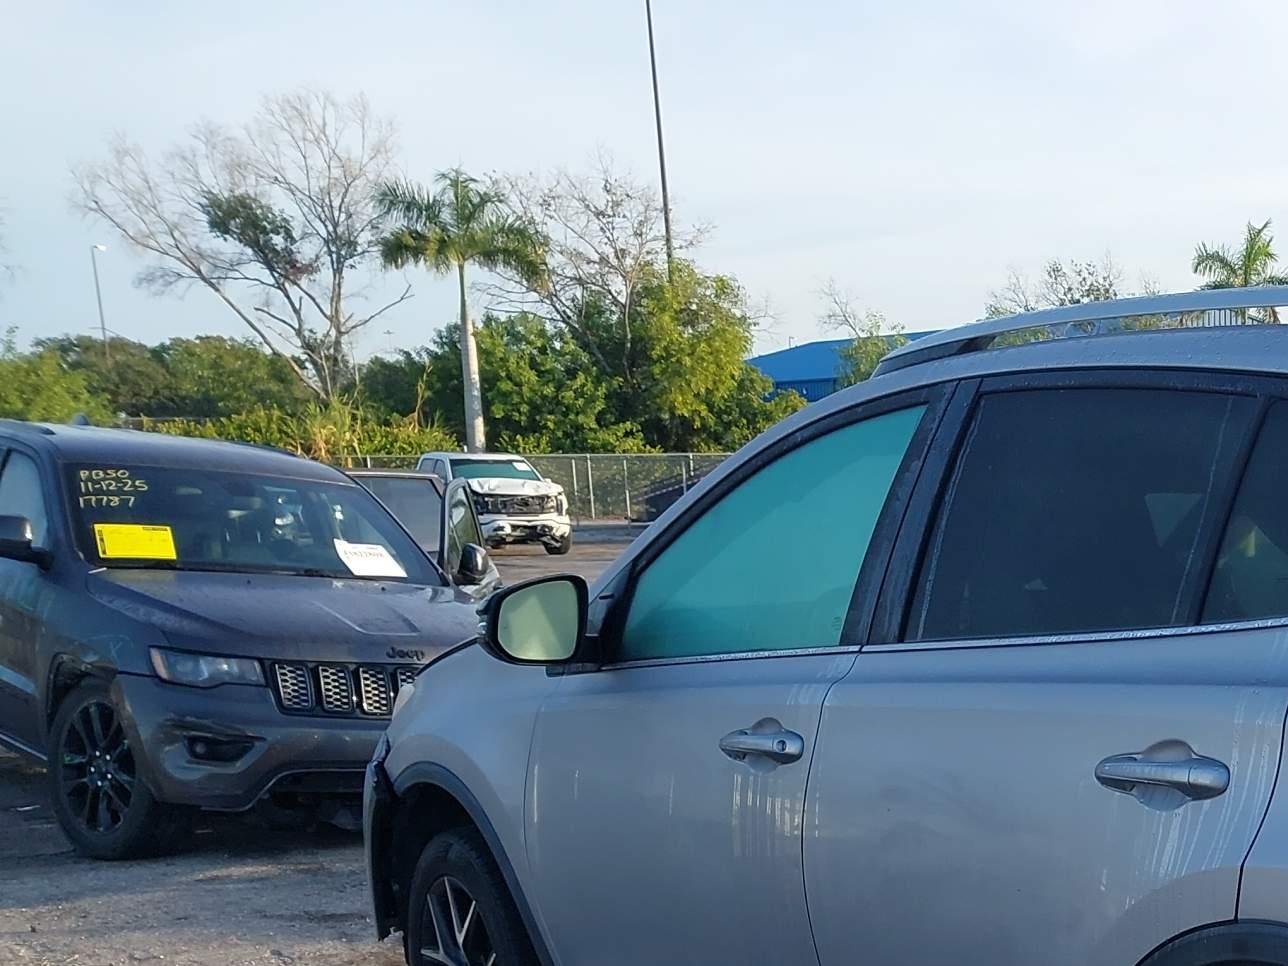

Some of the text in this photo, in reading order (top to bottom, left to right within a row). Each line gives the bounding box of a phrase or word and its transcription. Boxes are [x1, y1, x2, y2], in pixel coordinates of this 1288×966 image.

[80, 480, 148, 493] 11-12-25
[79, 495, 135, 509] 17787
[385, 645, 425, 661] Jeep
